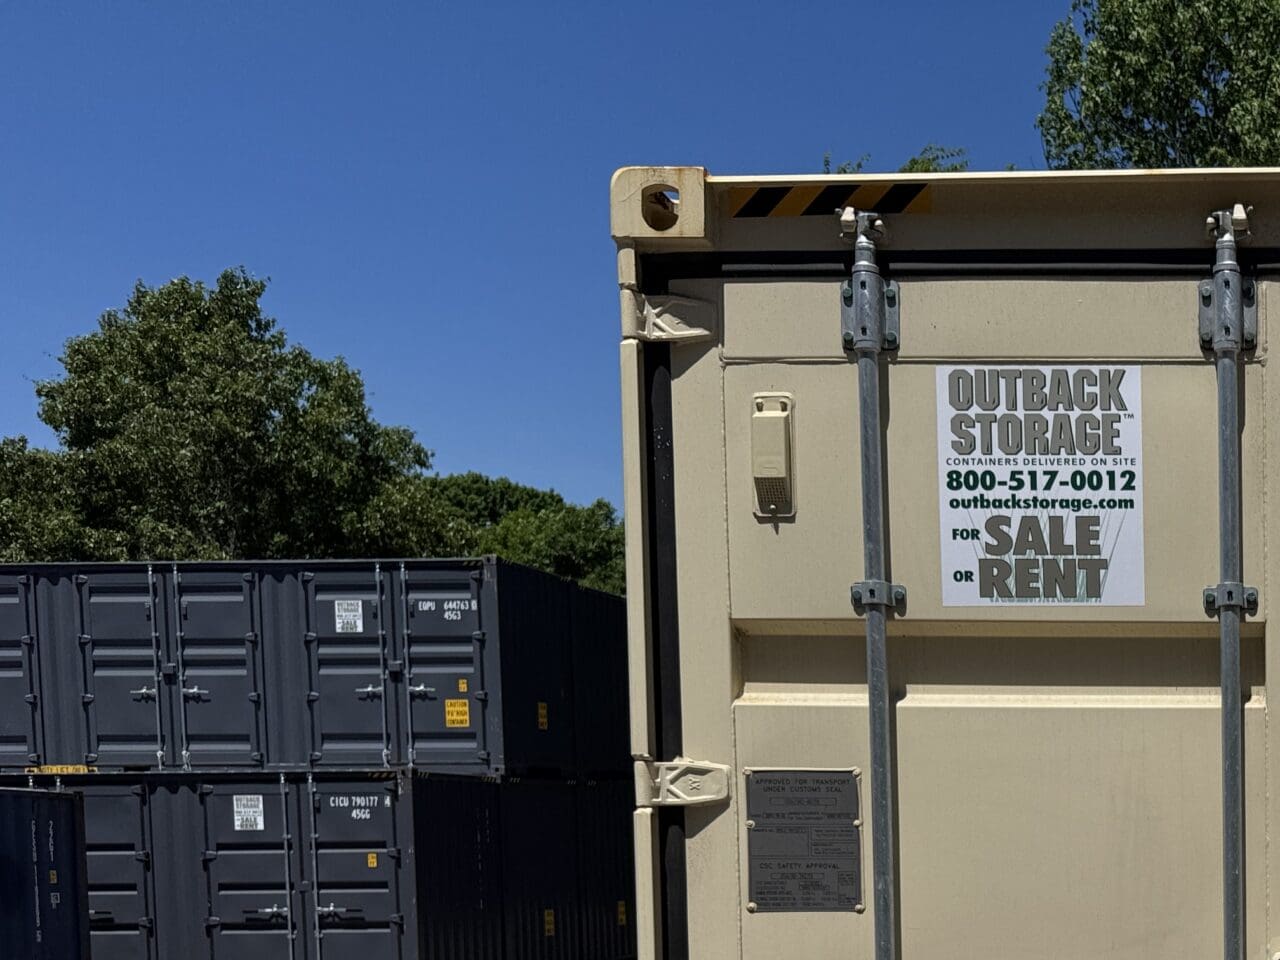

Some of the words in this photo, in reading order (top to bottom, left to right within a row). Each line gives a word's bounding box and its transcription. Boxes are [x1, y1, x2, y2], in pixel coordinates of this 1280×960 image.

[948, 369, 1128, 412] OUTBACK
[950, 413, 1123, 456] STORAGE
[946, 458, 1019, 466] CONTAINERS
[1023, 458, 1086, 466] DELIVERED
[1091, 458, 1108, 466] ON
[1112, 458, 1137, 466] SITE
[946, 470, 1136, 491] 800-517-0012
[949, 494, 1135, 512] outbackstorage.com
[952, 528, 980, 540] FOR
[984, 515, 1101, 556] SALE
[953, 570, 974, 583] OR
[978, 558, 1108, 598] RENT
